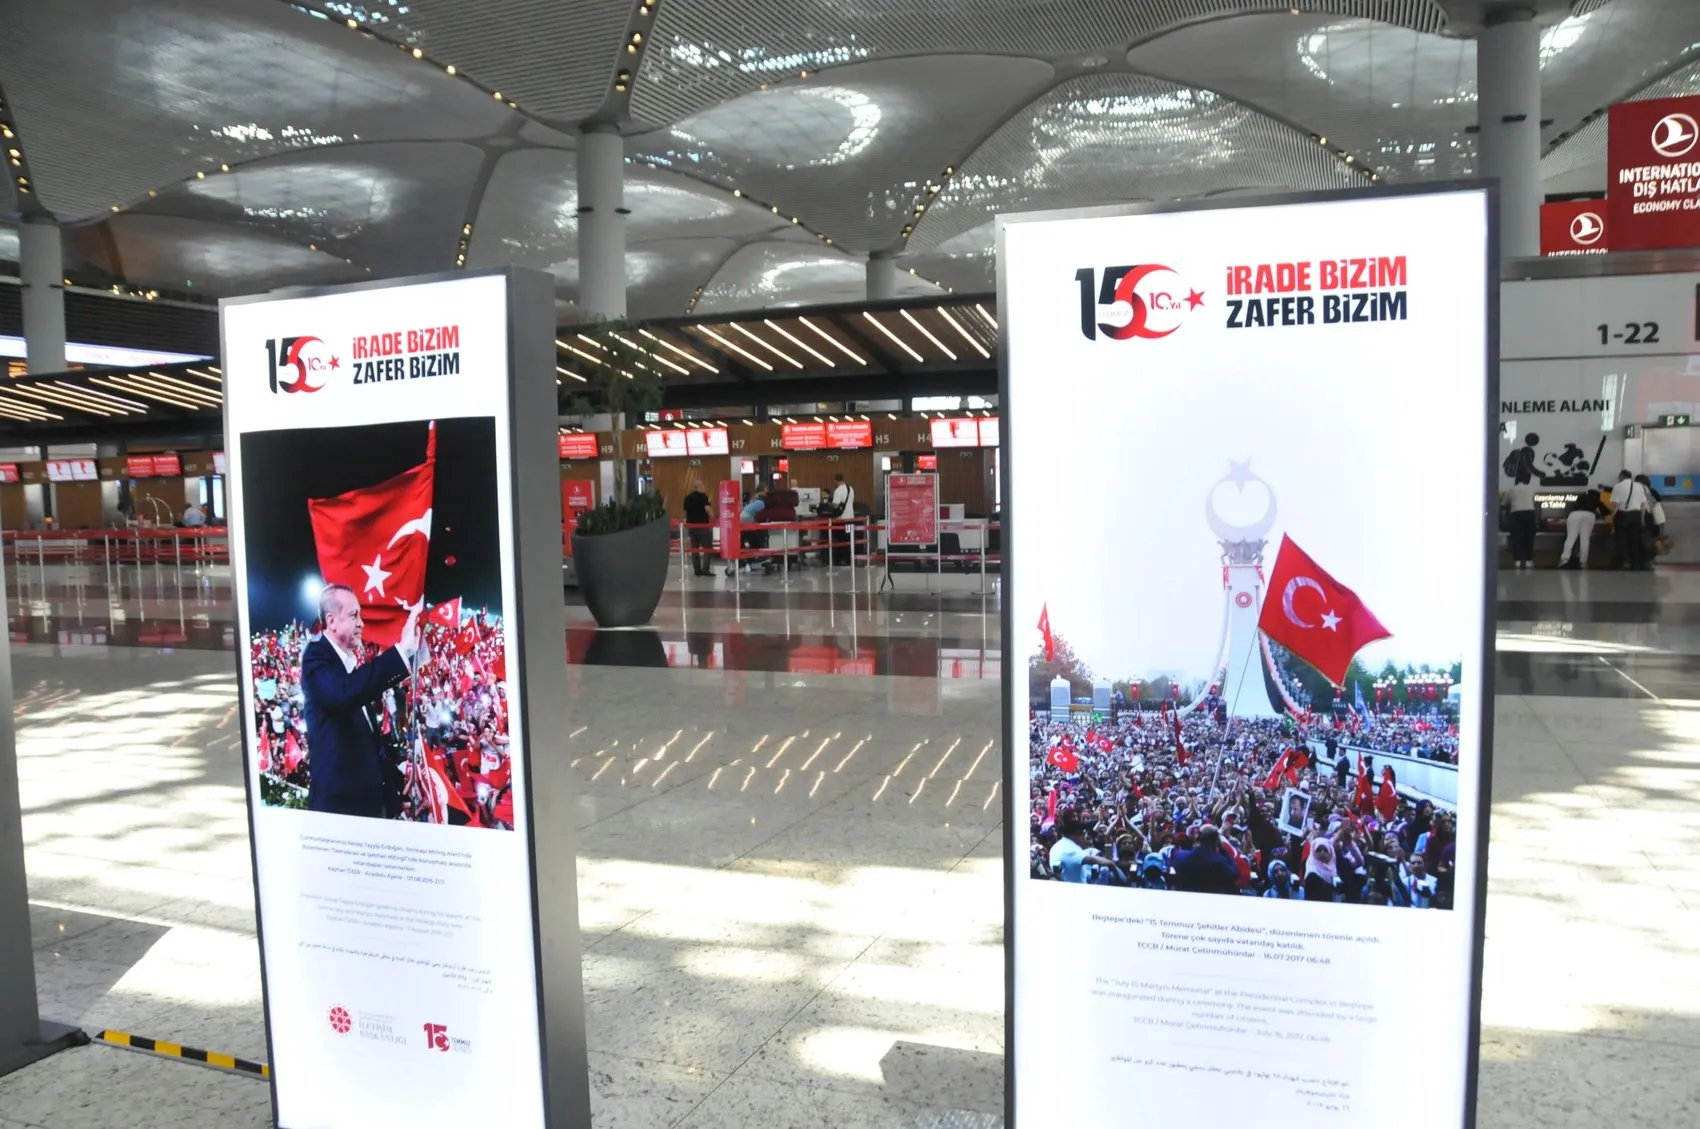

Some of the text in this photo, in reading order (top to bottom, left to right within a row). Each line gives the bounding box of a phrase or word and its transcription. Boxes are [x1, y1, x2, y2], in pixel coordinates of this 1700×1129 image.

[1633, 180, 1657, 198] DIŞ
[1633, 199, 1682, 214] ECONOMY
[1226, 255, 1407, 296] İRADE BİZİM
[1226, 290, 1407, 329] ZAFER BİZİM
[352, 325, 460, 359] İRADE BİZİM
[1597, 321, 1660, 345] 1-22
[352, 352, 460, 384] ZAFER BİZİM
[1560, 399, 1609, 412] ALANI
[732, 439, 745, 449] H7
[876, 434, 889, 444] H5
[1159, 919, 1193, 929] Temmuz
